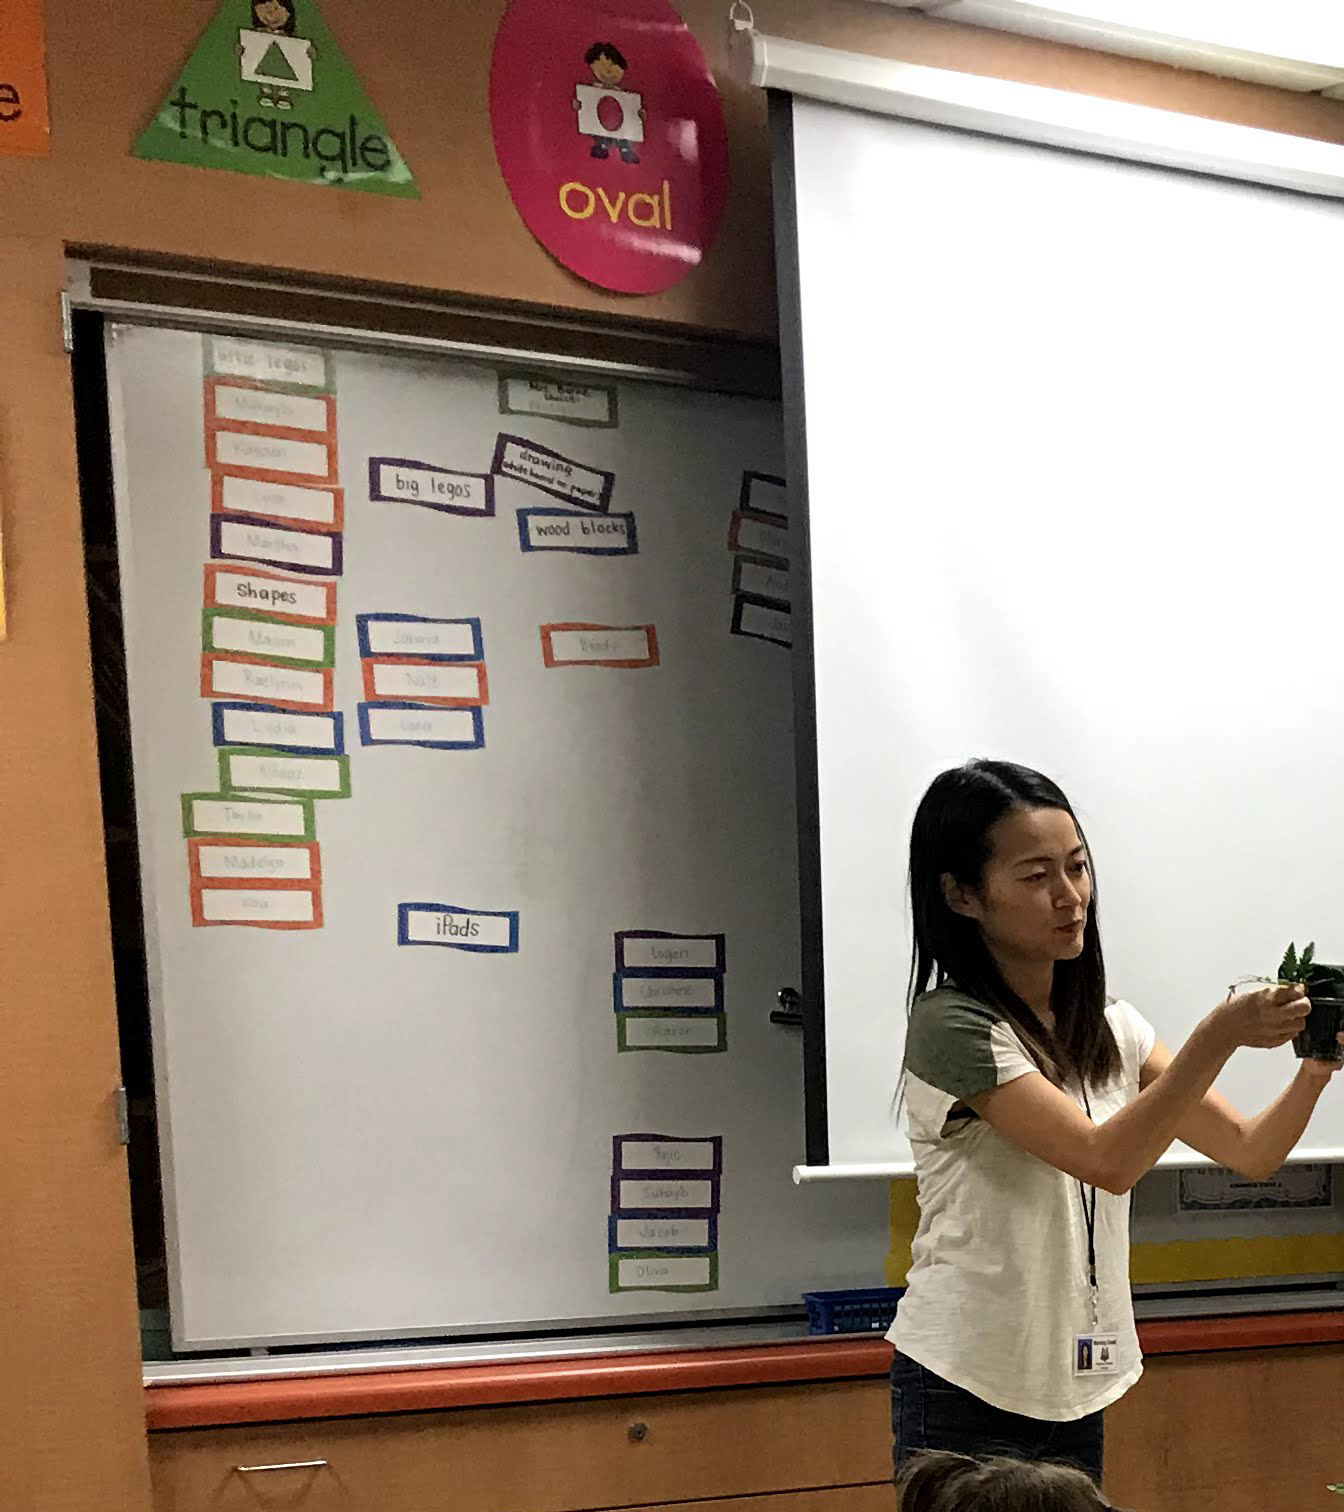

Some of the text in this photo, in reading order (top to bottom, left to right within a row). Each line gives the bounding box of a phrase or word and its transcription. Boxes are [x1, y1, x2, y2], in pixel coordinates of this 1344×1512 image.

[170, 90, 391, 184] triangle
[559, 179, 674, 231] oval
[520, 447, 573, 477] drawing
[396, 473, 471, 500] big legos
[536, 516, 626, 537] wood blocks
[237, 582, 297, 606] shapes
[435, 914, 480, 938] iPads
